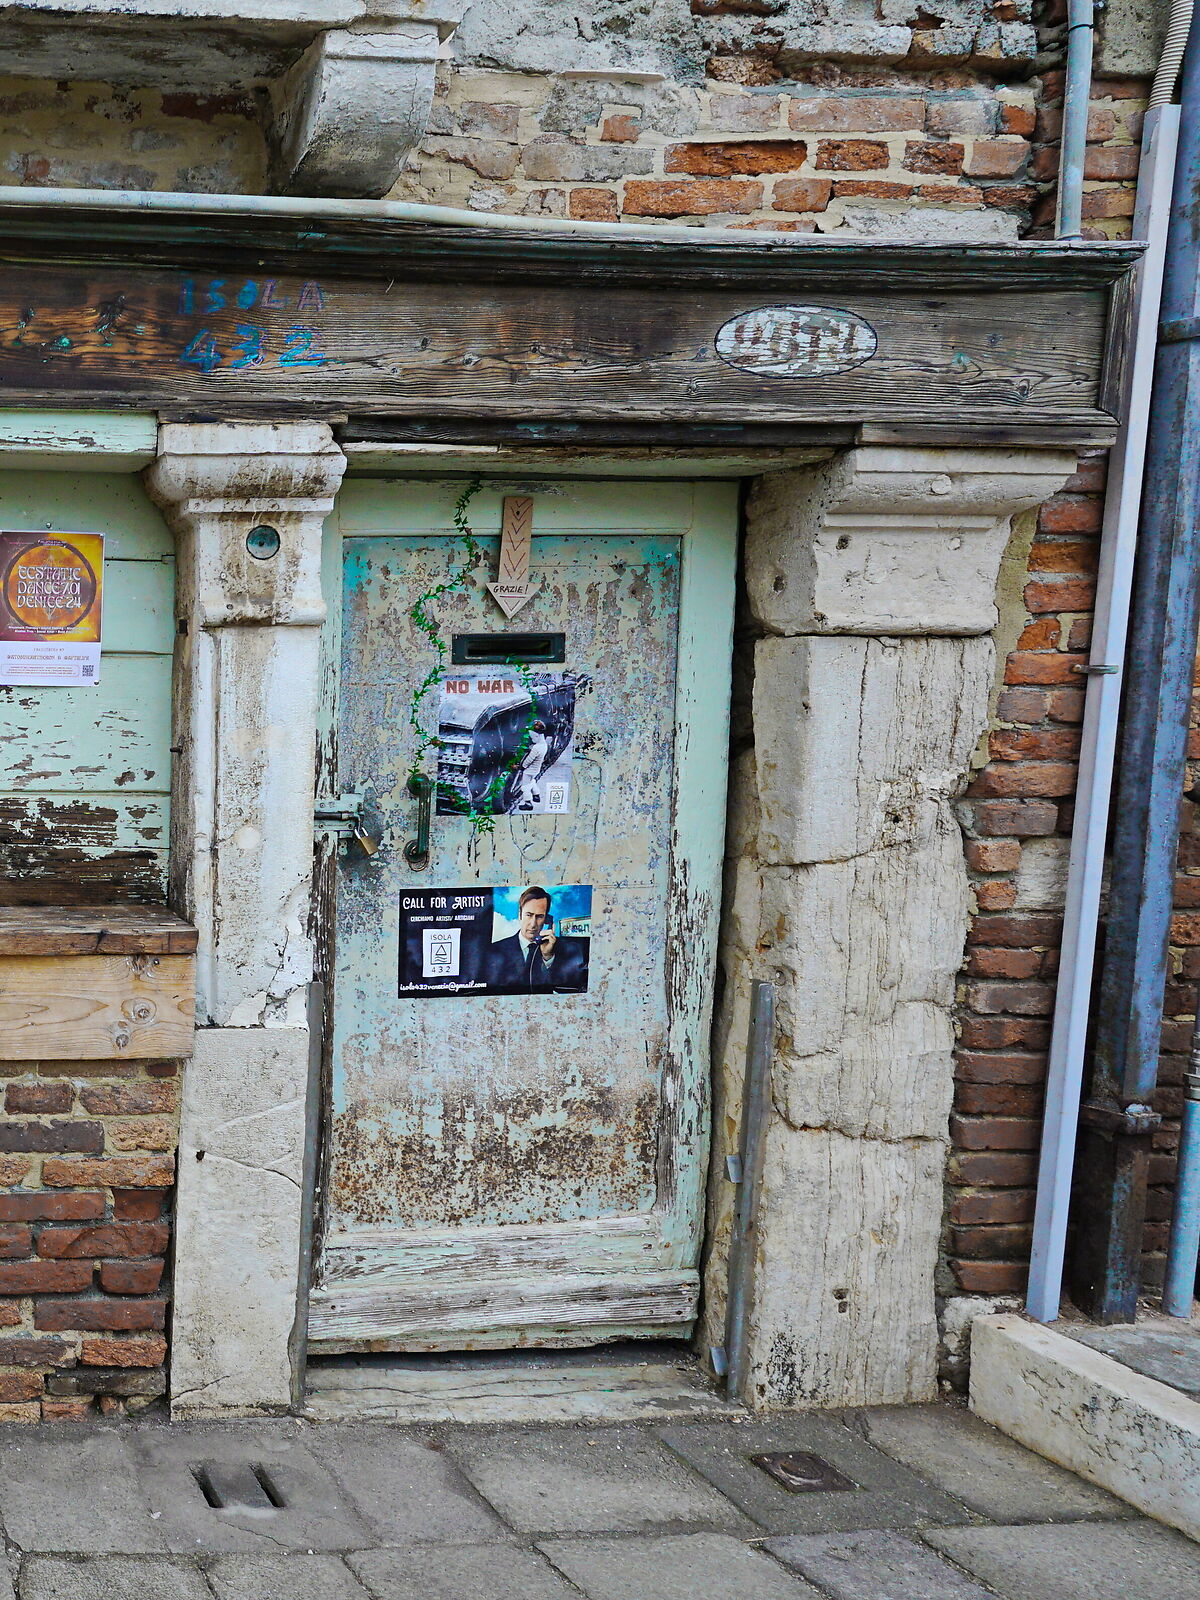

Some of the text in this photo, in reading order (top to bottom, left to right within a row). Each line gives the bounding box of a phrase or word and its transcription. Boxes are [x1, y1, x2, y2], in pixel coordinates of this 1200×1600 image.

[179, 279, 324, 314] ISOLA
[18, 565, 81, 580] ECSTATIC
[17, 581, 61, 594] DANCE
[493, 584, 529, 595] GRAZIE!
[446, 679, 515, 694] NO WAR
[402, 896, 485, 910] CALL FOR ARTIST
